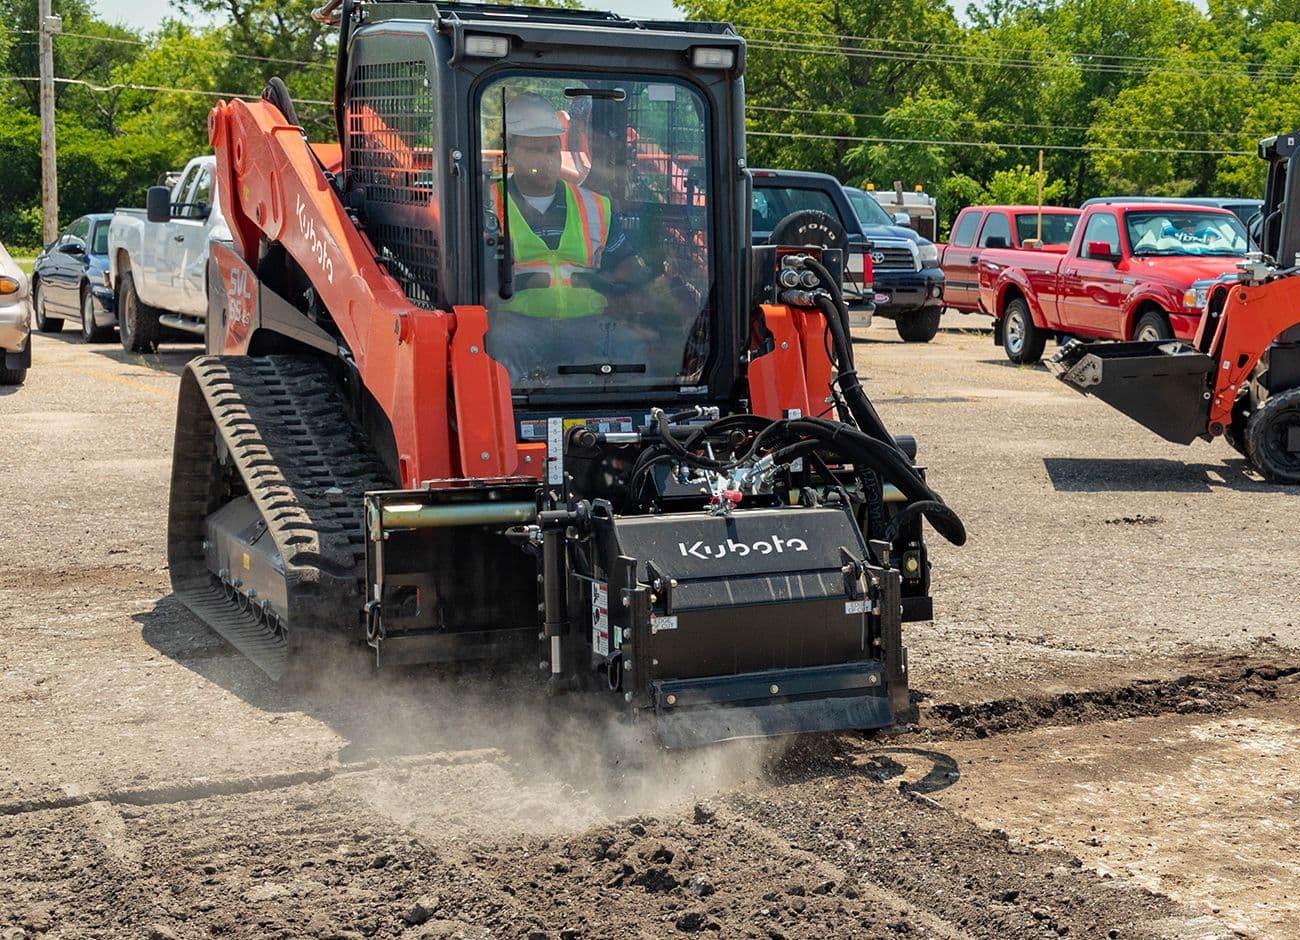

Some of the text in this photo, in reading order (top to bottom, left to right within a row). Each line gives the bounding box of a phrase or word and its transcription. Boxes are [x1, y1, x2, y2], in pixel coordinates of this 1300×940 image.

[296, 193, 333, 284] Kubota
[799, 223, 836, 241] FORD
[229, 268, 251, 298] SVL
[678, 535, 808, 560] Kubota
